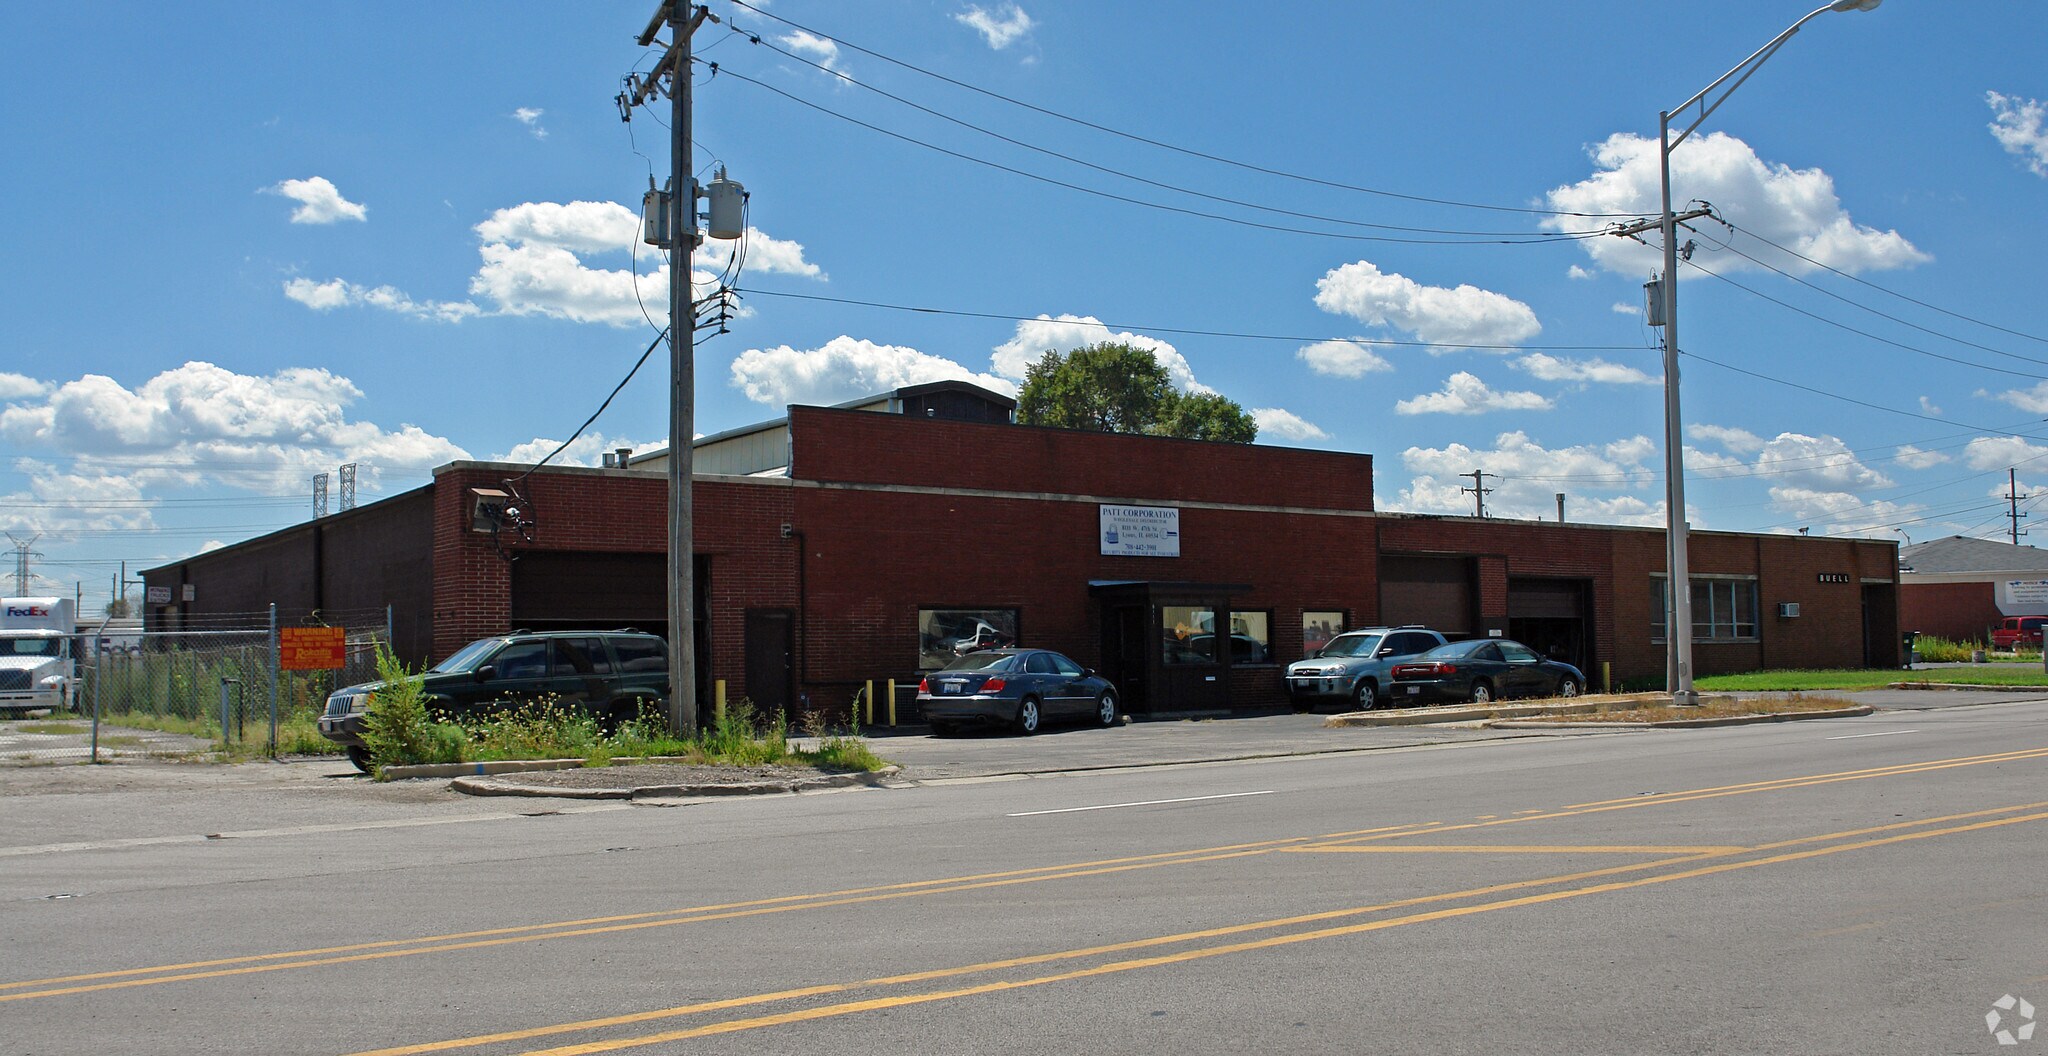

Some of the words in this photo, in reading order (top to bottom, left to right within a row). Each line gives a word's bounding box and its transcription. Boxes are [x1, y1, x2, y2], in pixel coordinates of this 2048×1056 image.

[1103, 508, 1120, 516] PATT
[1123, 508, 1176, 518] CORPORATION
[7, 606, 49, 617] FedEx
[293, 628, 333, 636] WARNING
